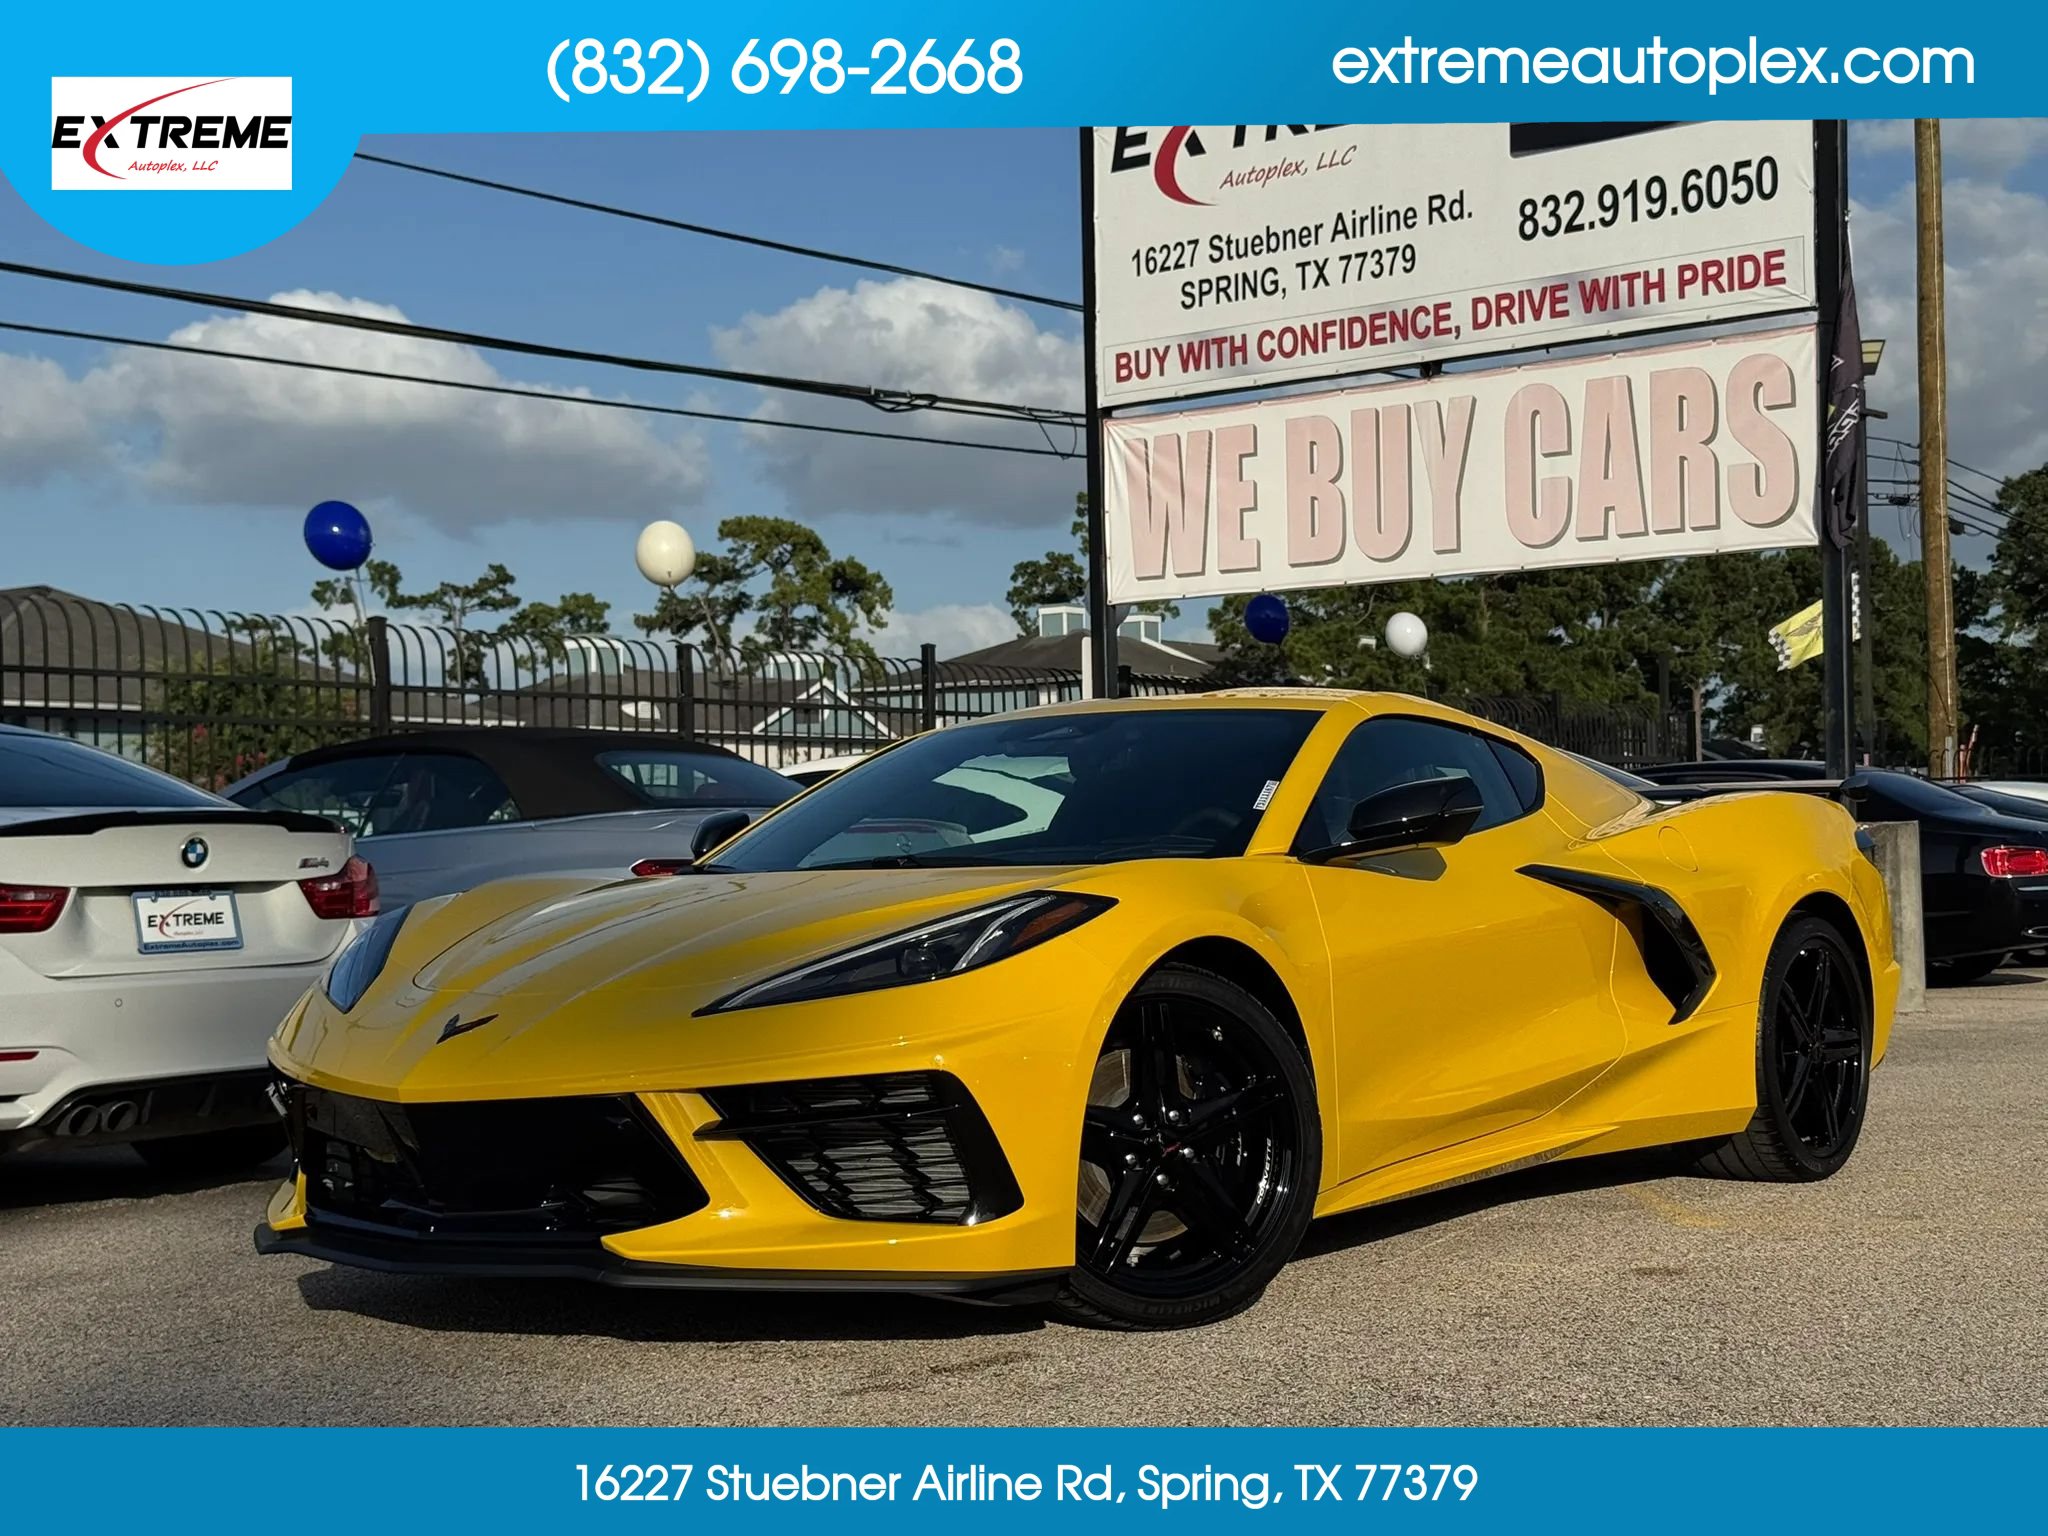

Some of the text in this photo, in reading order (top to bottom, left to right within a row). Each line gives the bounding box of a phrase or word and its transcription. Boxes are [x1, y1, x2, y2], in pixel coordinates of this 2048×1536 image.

[1219, 145, 1357, 188] Autoplex, LLC
[1518, 155, 1779, 241] 832.919.6050
[1131, 189, 1473, 277] 16227 Stuebner Airline Rd.
[1115, 249, 1787, 384] BUY WITH CONFIDENCE, DRIVE WITH PRIDE
[1180, 243, 1417, 310] SPRING, TX 77379
[1124, 353, 1798, 581] WE BUY CARS
[147, 912, 225, 928] EXTREME
